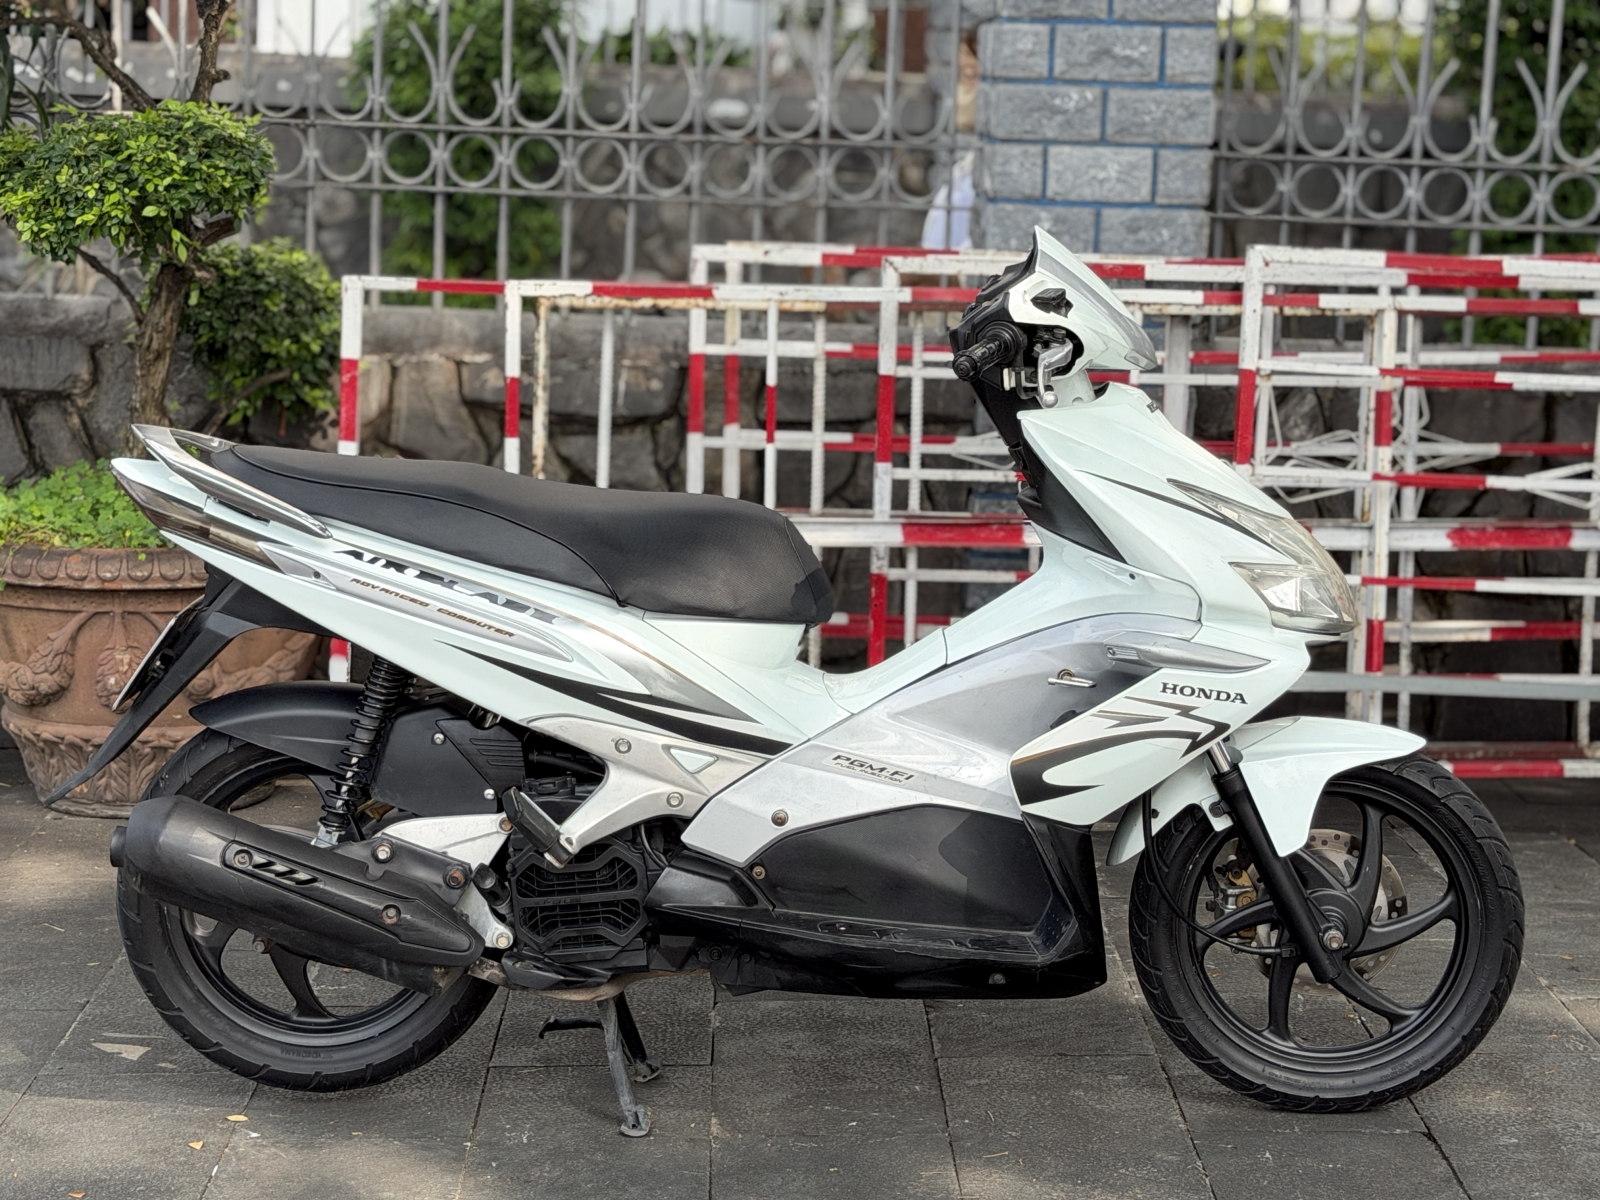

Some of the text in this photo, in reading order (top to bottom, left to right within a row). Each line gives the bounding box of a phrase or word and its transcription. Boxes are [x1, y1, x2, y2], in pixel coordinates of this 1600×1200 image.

[349, 578, 516, 638] ADVANCED COMMUTER
[1159, 681, 1249, 705] HONDA
[835, 762, 904, 784] FUEL INJECTION
